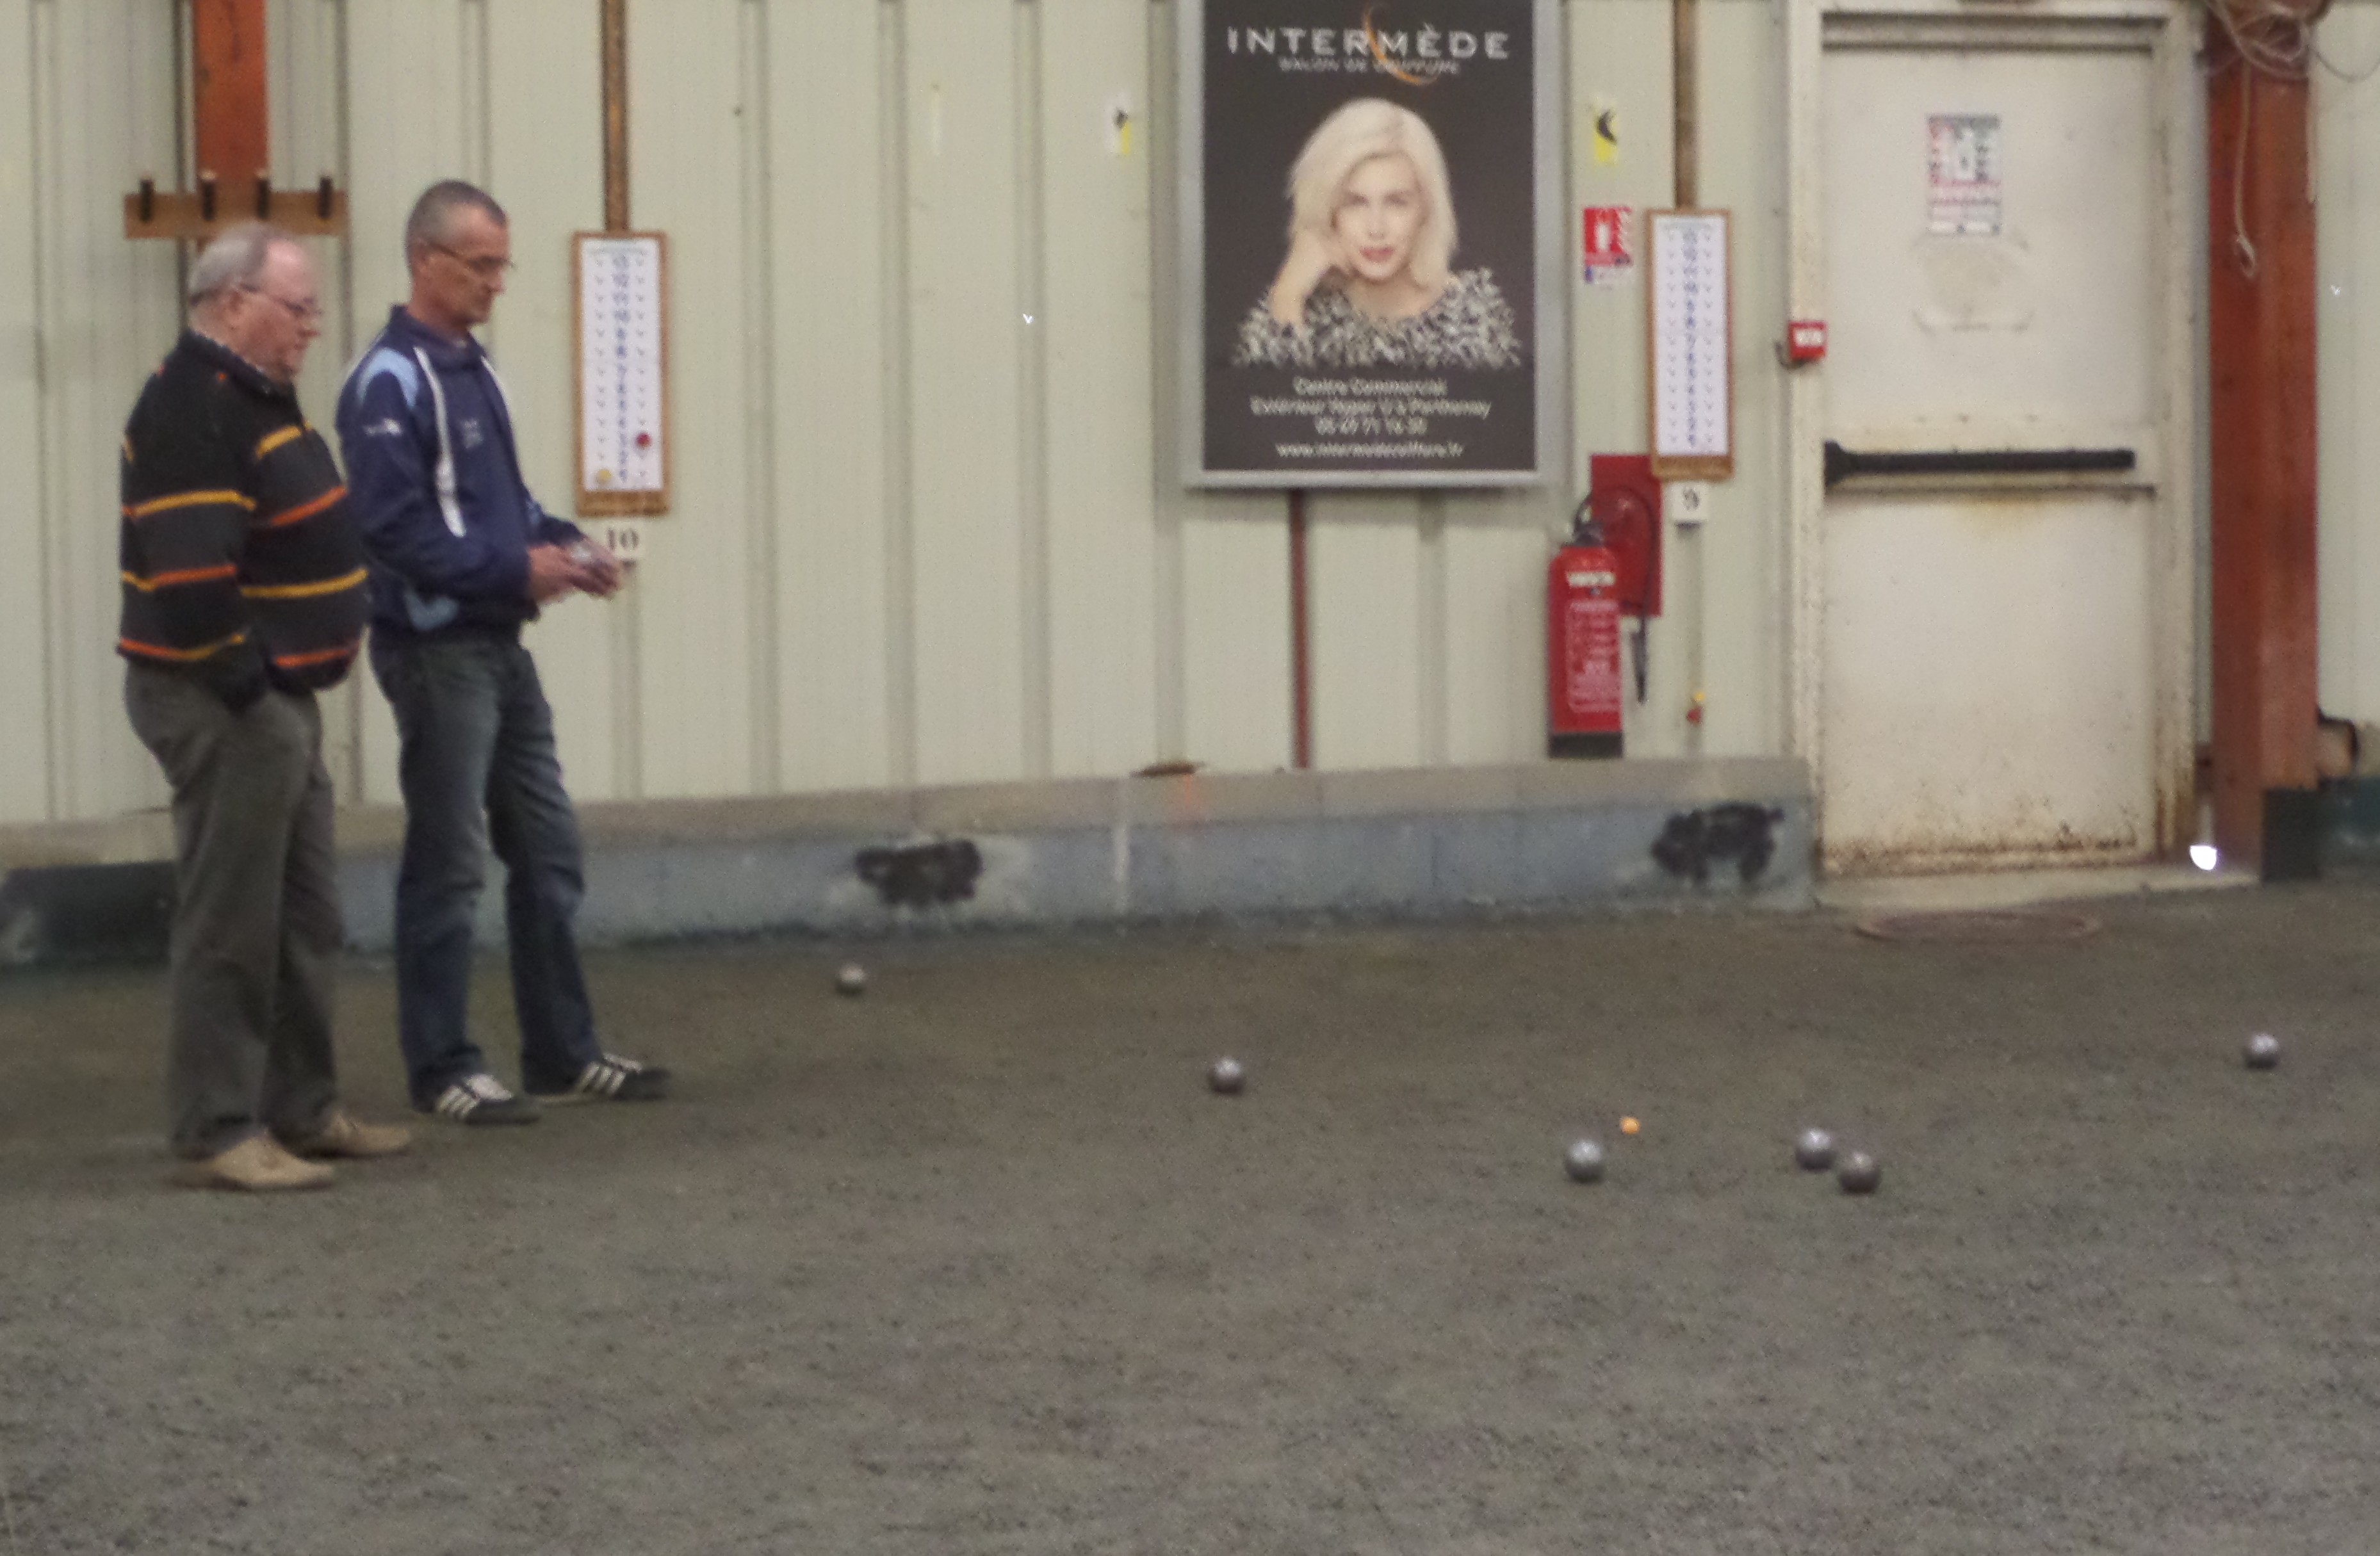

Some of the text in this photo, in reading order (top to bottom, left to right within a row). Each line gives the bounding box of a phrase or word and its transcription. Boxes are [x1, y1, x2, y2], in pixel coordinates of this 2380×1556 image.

[1227, 23, 1510, 60] INTERMÈDE
[1293, 377, 1447, 395] Centre Commercial
[1408, 398, 1492, 419] Parthenay
[607, 527, 640, 551] 10
